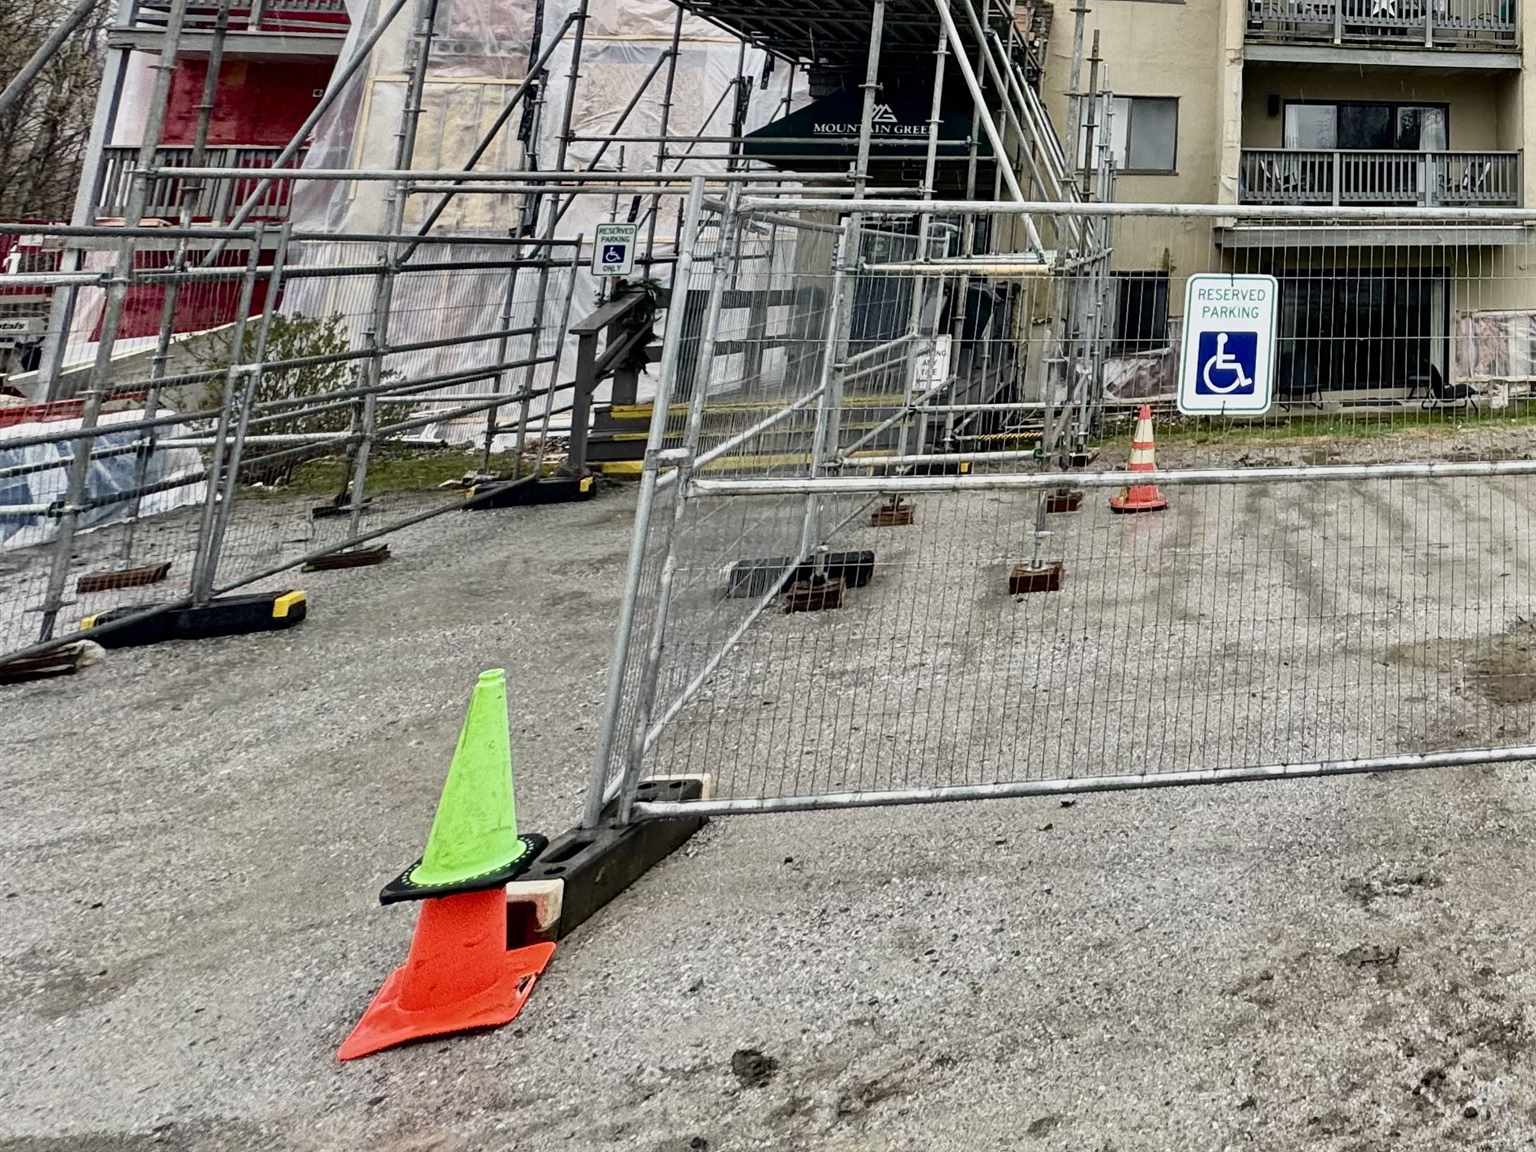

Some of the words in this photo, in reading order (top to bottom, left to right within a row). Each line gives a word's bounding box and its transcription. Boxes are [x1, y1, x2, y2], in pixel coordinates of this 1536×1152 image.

[894, 125, 932, 135] GREE
[1198, 288, 1266, 301] RESERVED
[1202, 306, 1259, 319] PARKING
